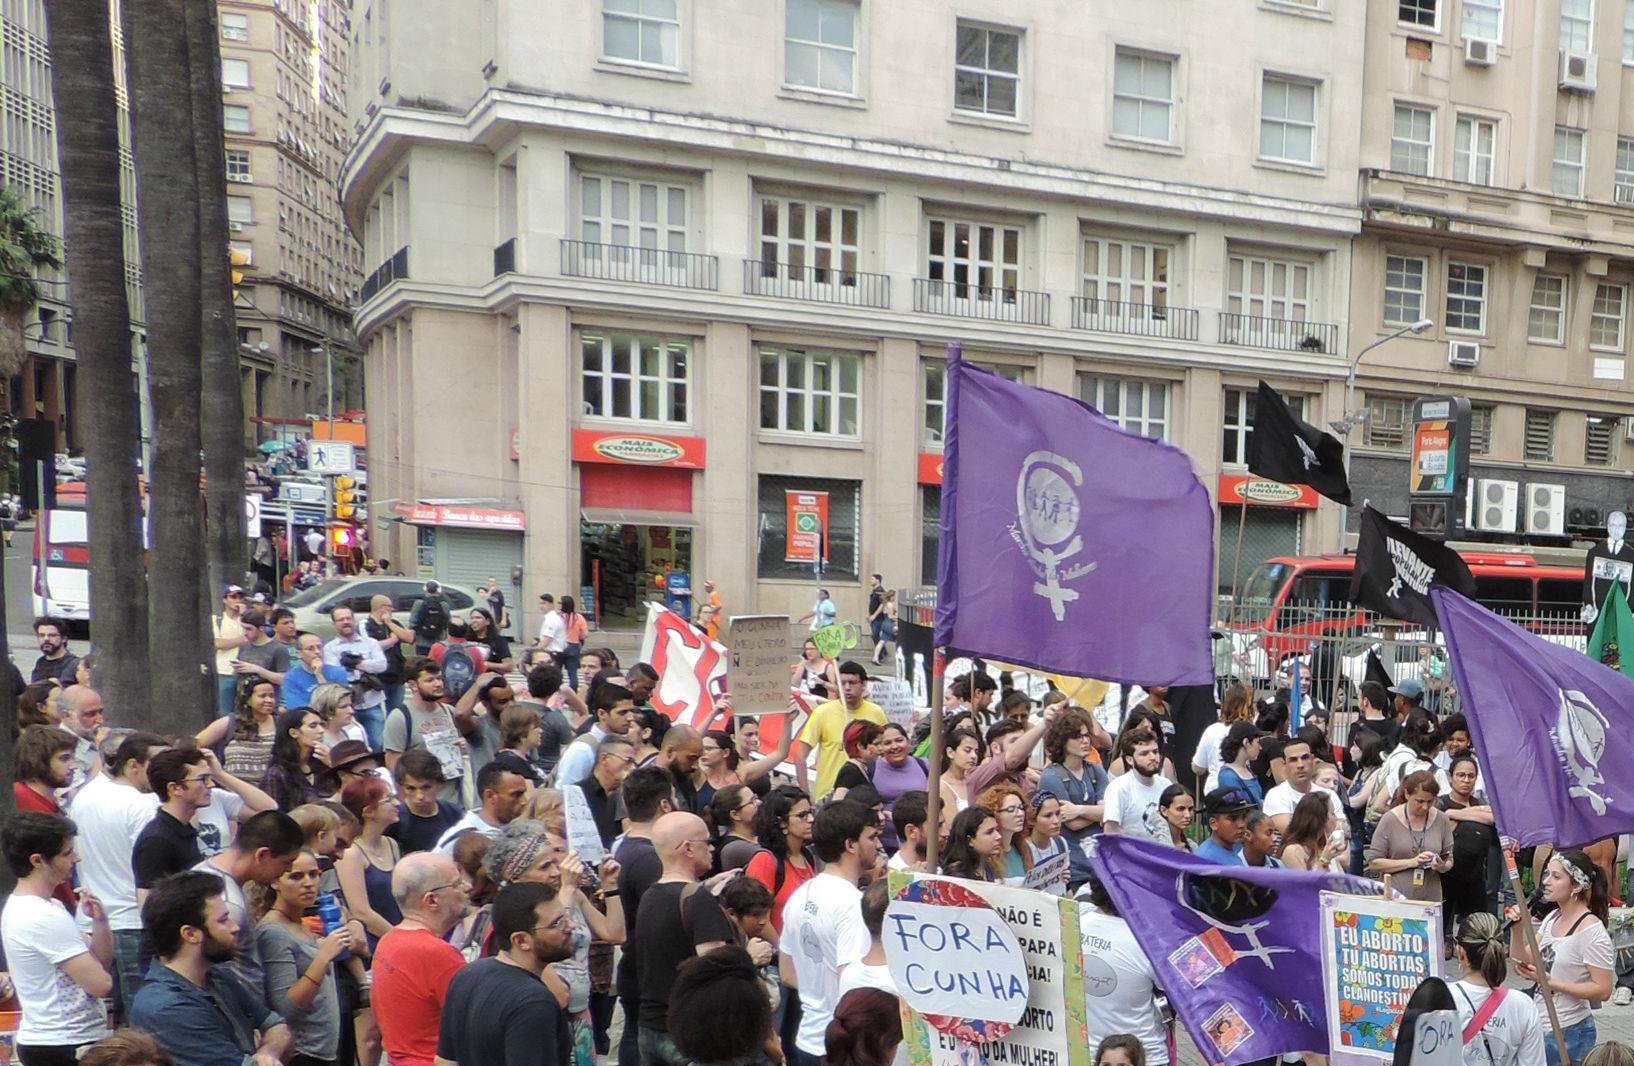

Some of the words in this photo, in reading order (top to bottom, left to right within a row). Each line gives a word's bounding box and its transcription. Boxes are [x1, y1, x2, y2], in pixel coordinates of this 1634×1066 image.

[888, 914, 1010, 953] FORA
[1341, 925, 1358, 946] EU
[1362, 930, 1423, 954] ABORTO
[1343, 948, 1359, 966] TU
[1363, 952, 1424, 974] ABORTAS
[905, 963, 1027, 1001] CUNHA
[1342, 968, 1382, 988] SOMOS
[1385, 973, 1424, 990] TODAS
[1343, 986, 1412, 1006] CLANDESTIN
[1420, 1020, 1454, 1055] ORA
[993, 1040, 1007, 1063] DA
